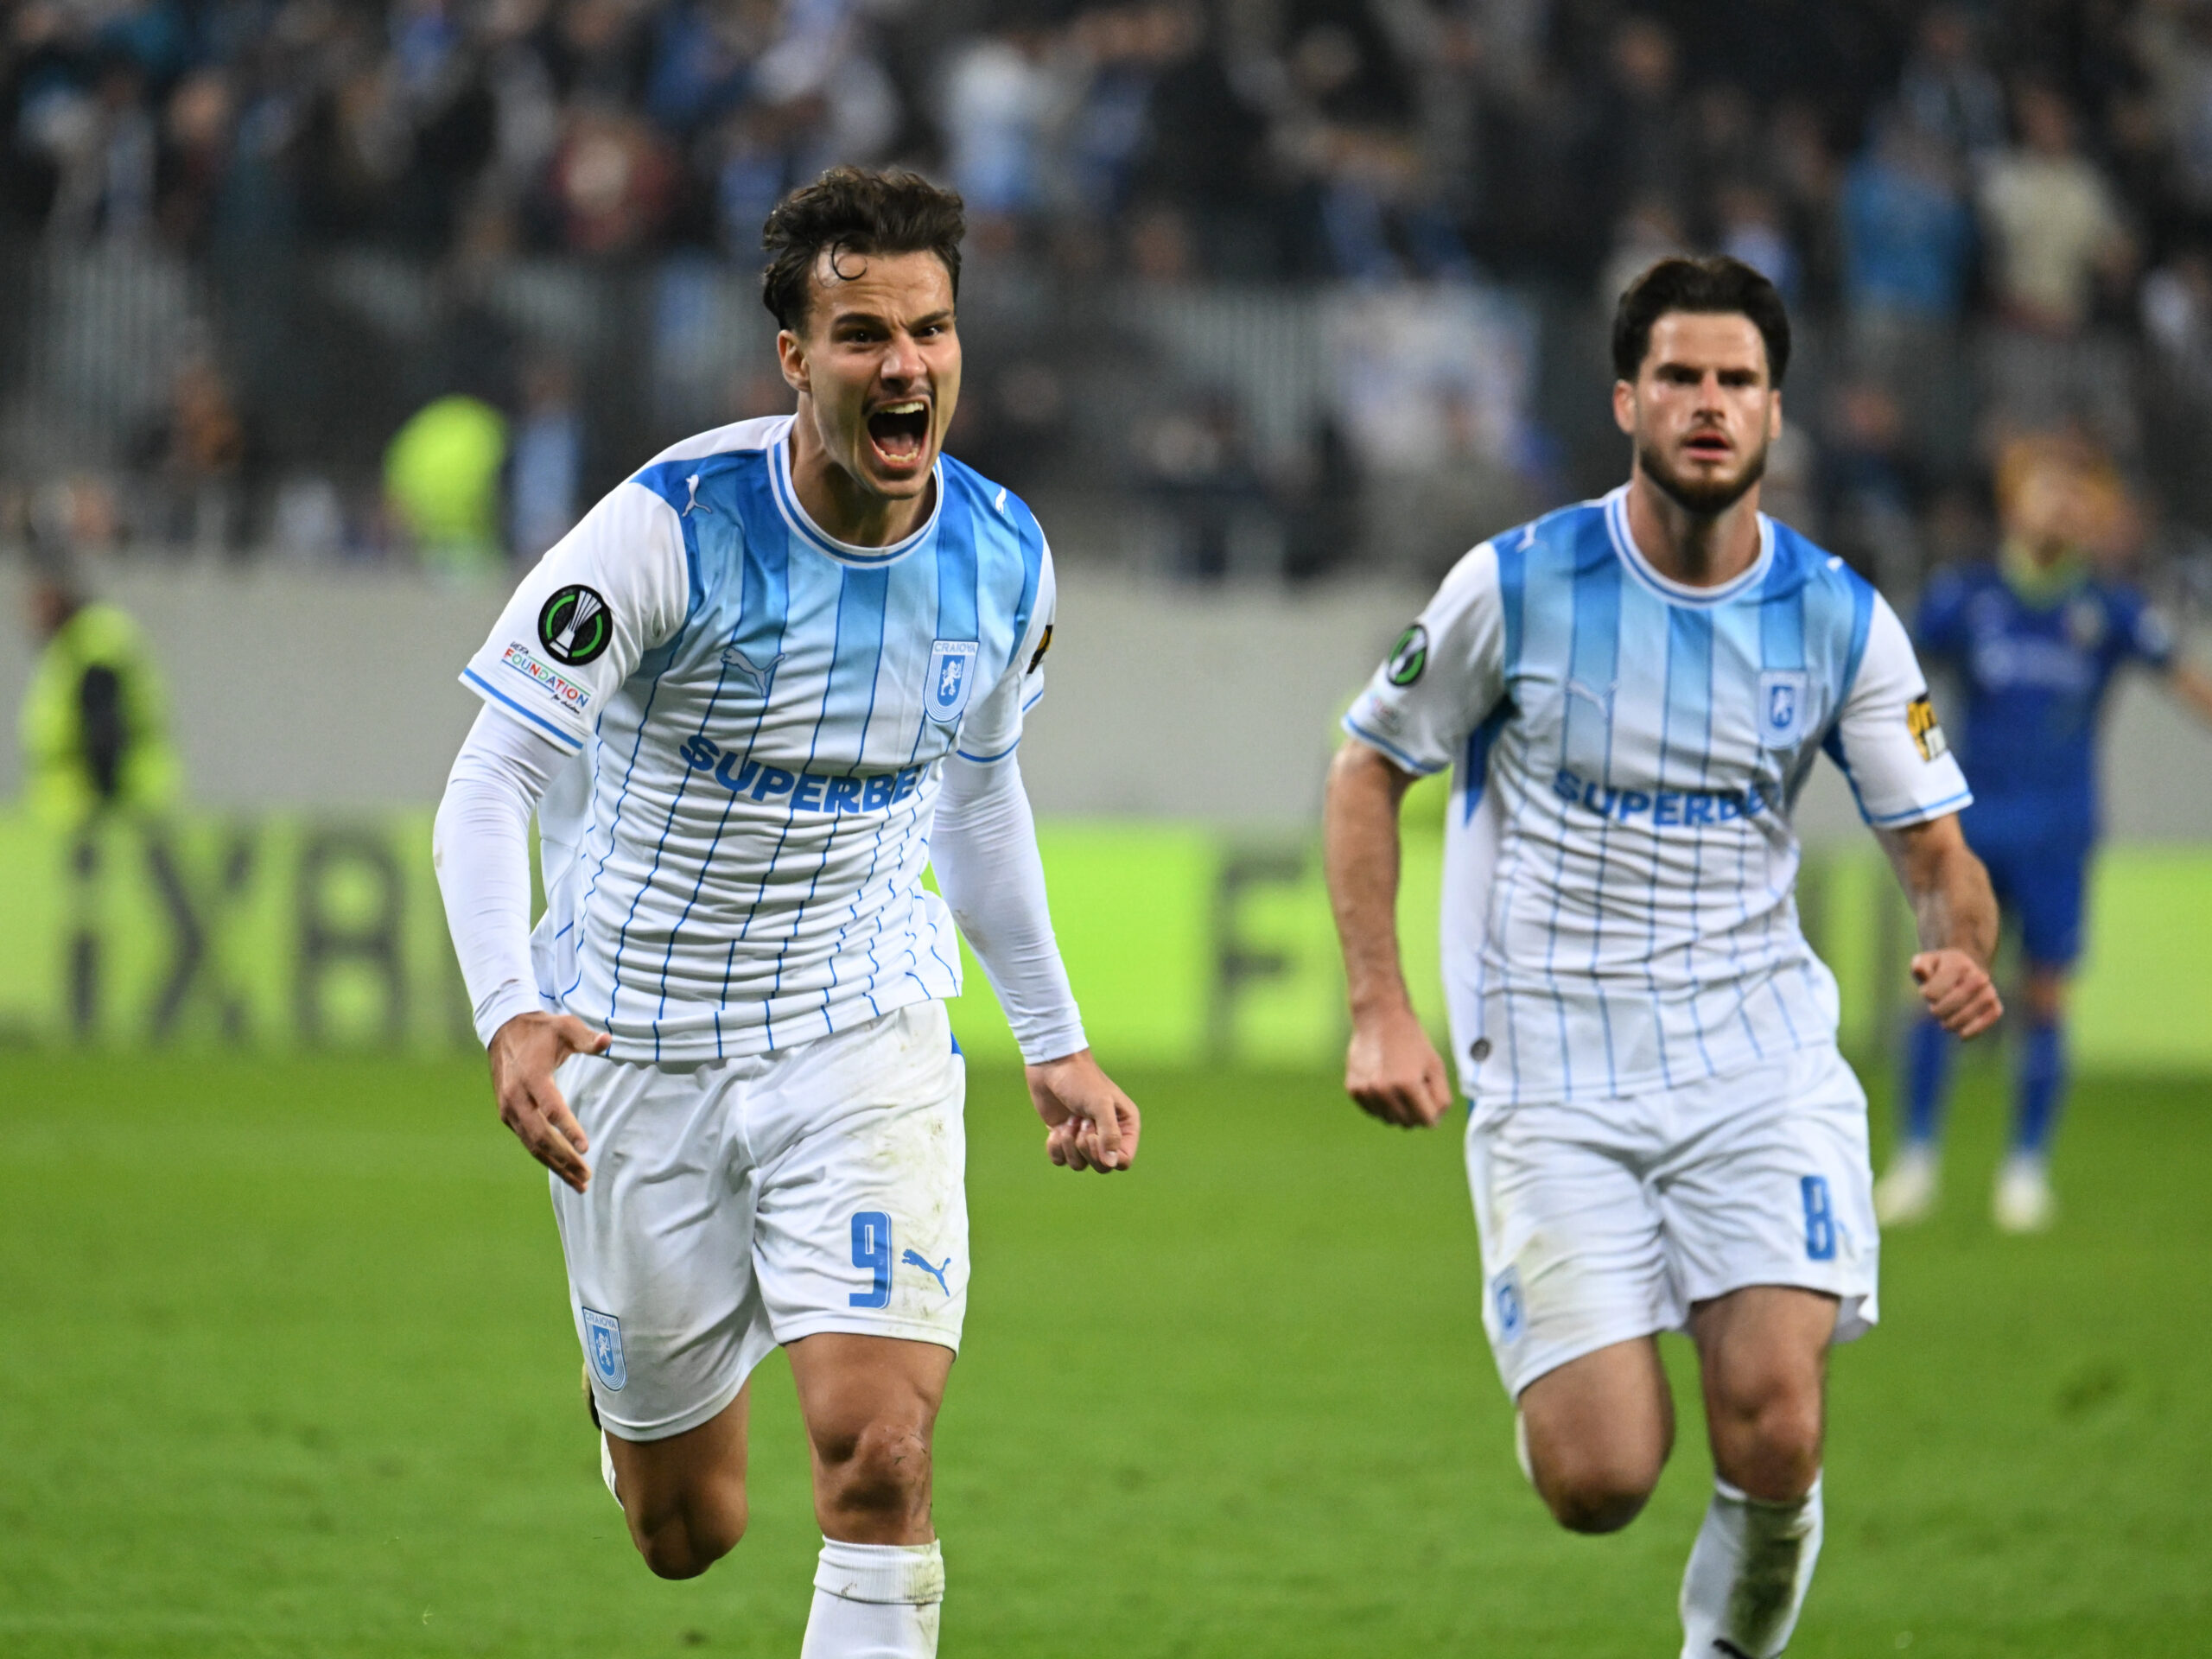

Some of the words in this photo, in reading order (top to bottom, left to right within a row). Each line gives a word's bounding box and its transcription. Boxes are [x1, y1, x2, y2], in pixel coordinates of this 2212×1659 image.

[509, 641, 529, 655] UEFA
[934, 642, 976, 653] CRAIOVA
[504, 648, 589, 708] FOUNDATION
[1801, 1175, 1835, 1261] 8
[849, 1211, 892, 1309] 9
